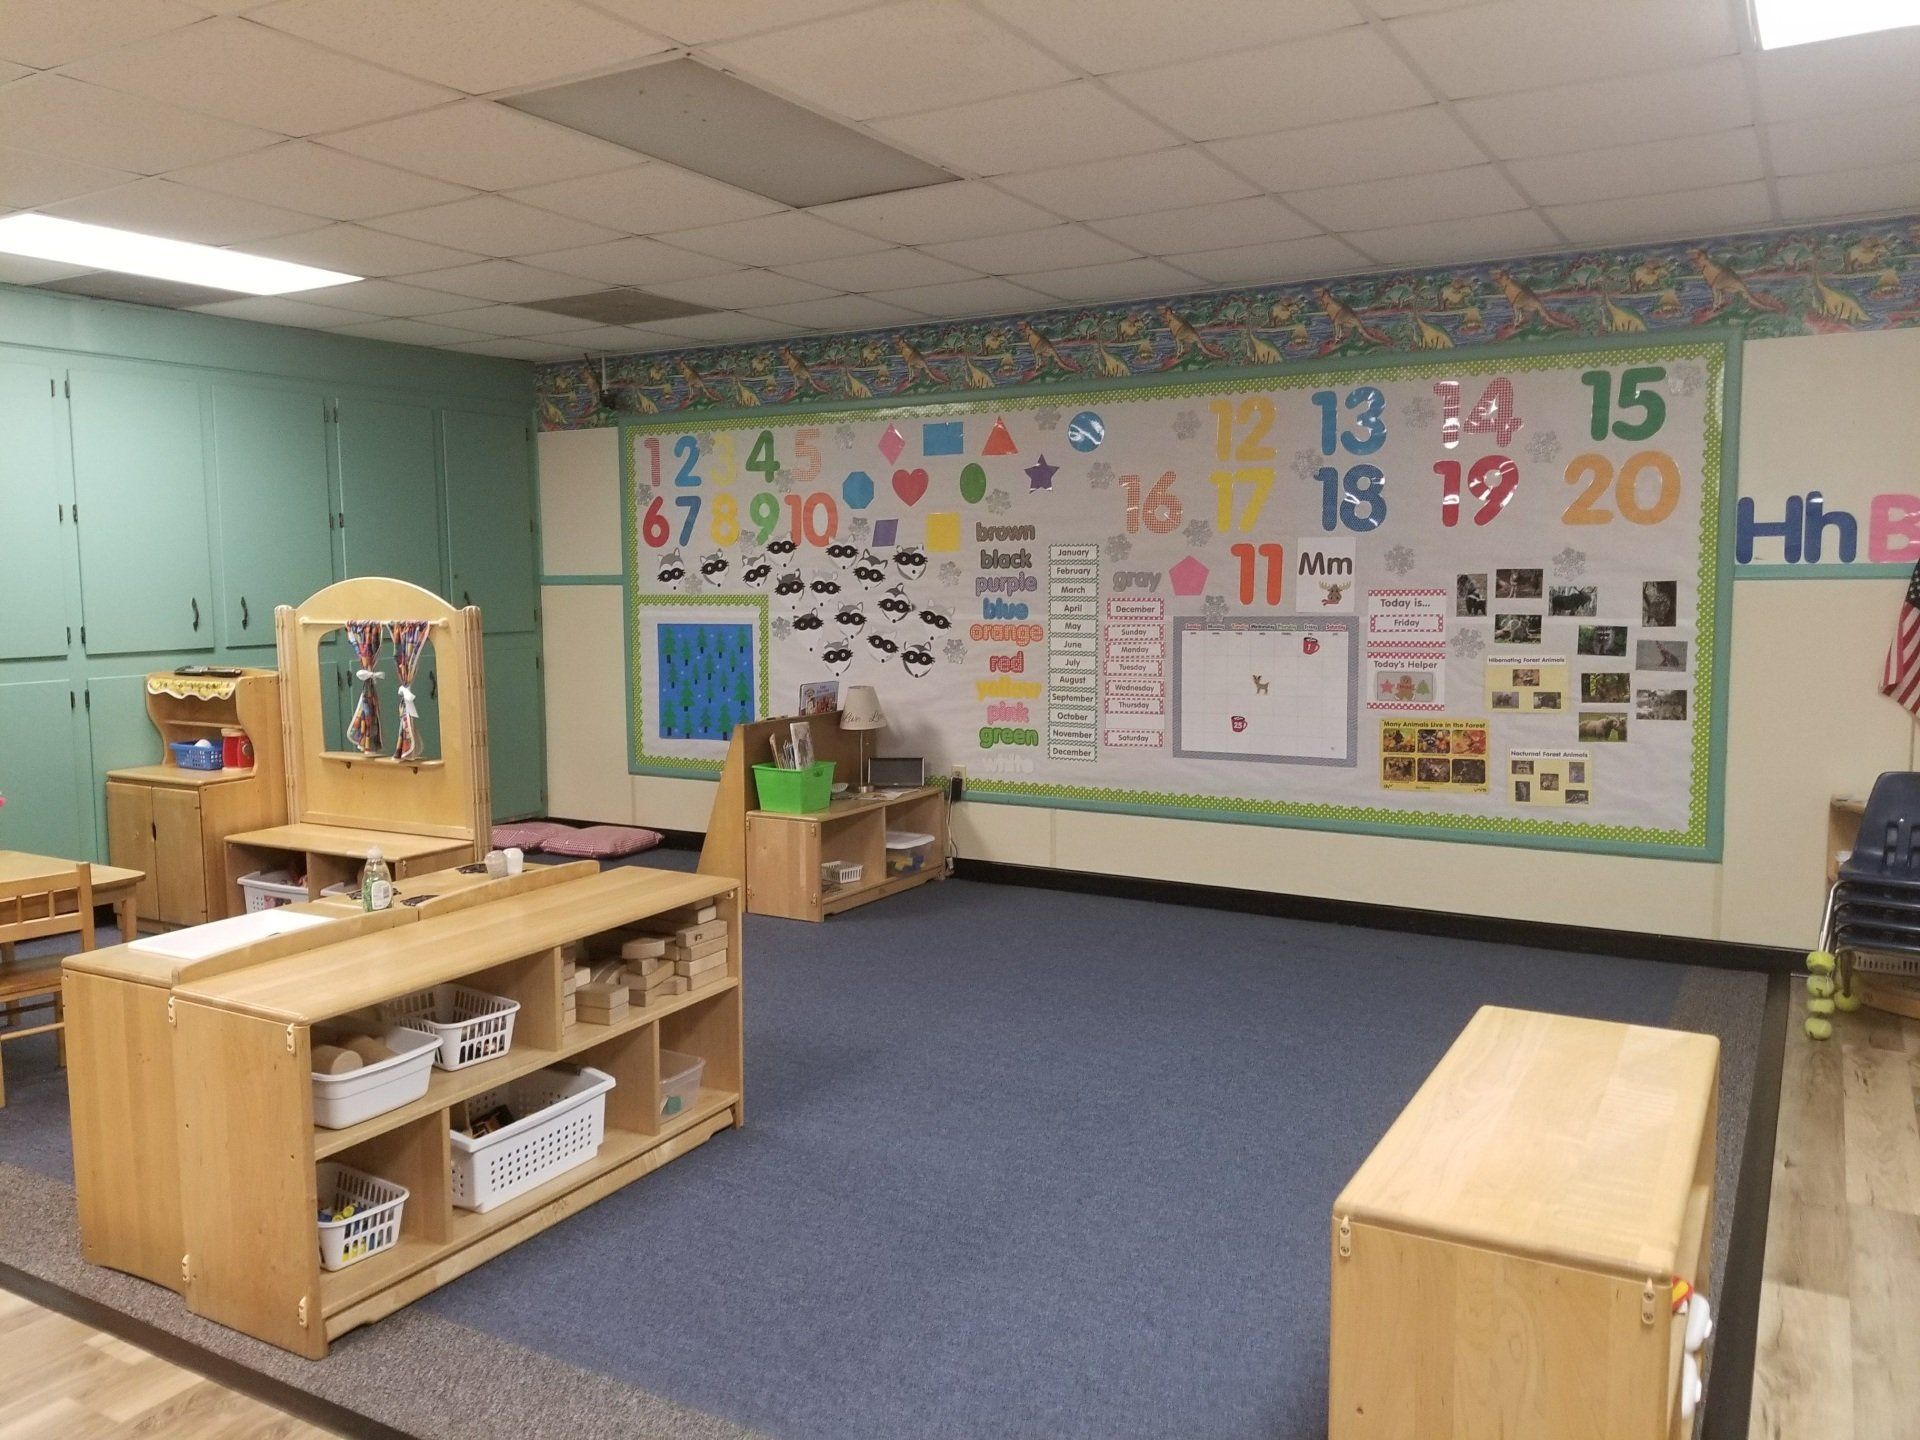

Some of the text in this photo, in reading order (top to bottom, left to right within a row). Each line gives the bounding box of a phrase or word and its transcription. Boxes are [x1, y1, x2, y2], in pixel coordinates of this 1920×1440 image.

[1208, 366, 1668, 462] 12 13 14 15
[644, 428, 822, 488] 1 2 3 4 5
[1118, 450, 1681, 534] 16 17 18 19 20
[642, 491, 839, 548] 6 7 8 9 10
[976, 522, 1036, 542] brown
[1736, 491, 1858, 564] Hh
[1058, 548, 1090, 558] January
[980, 548, 1032, 569] black
[1298, 551, 1353, 576] Mm
[1056, 567, 1091, 576] February
[1231, 543, 1283, 606] 11
[975, 572, 1037, 597] purple
[1113, 570, 1162, 592] gray
[1061, 586, 1086, 594] March
[983, 598, 1029, 620] blue
[1064, 604, 1082, 614] April
[1116, 605, 1155, 613] December
[1380, 599, 1430, 609] Today is...
[1064, 622, 1081, 631] May
[1394, 619, 1420, 628] Friday
[970, 624, 1044, 646] orange
[1121, 628, 1147, 637] Sunday
[1064, 641, 1082, 649] June
[1121, 646, 1149, 654] Monday
[990, 651, 1024, 673] red
[1064, 658, 1080, 667] July
[1374, 661, 1437, 670] Today's Helper
[1119, 663, 1147, 672] Tuesday
[1059, 675, 1086, 685] August
[976, 676, 1042, 701] yellow
[1115, 684, 1154, 693] Wednesday
[1052, 694, 1094, 704] September
[1119, 701, 1150, 710] Thursday
[987, 701, 1030, 725] pink
[1057, 712, 1088, 721] October
[1384, 721, 1400, 729] Many
[980, 727, 1038, 748] green
[1053, 730, 1092, 739] November
[1118, 734, 1149, 743] Saturday
[1053, 748, 1091, 757] December
